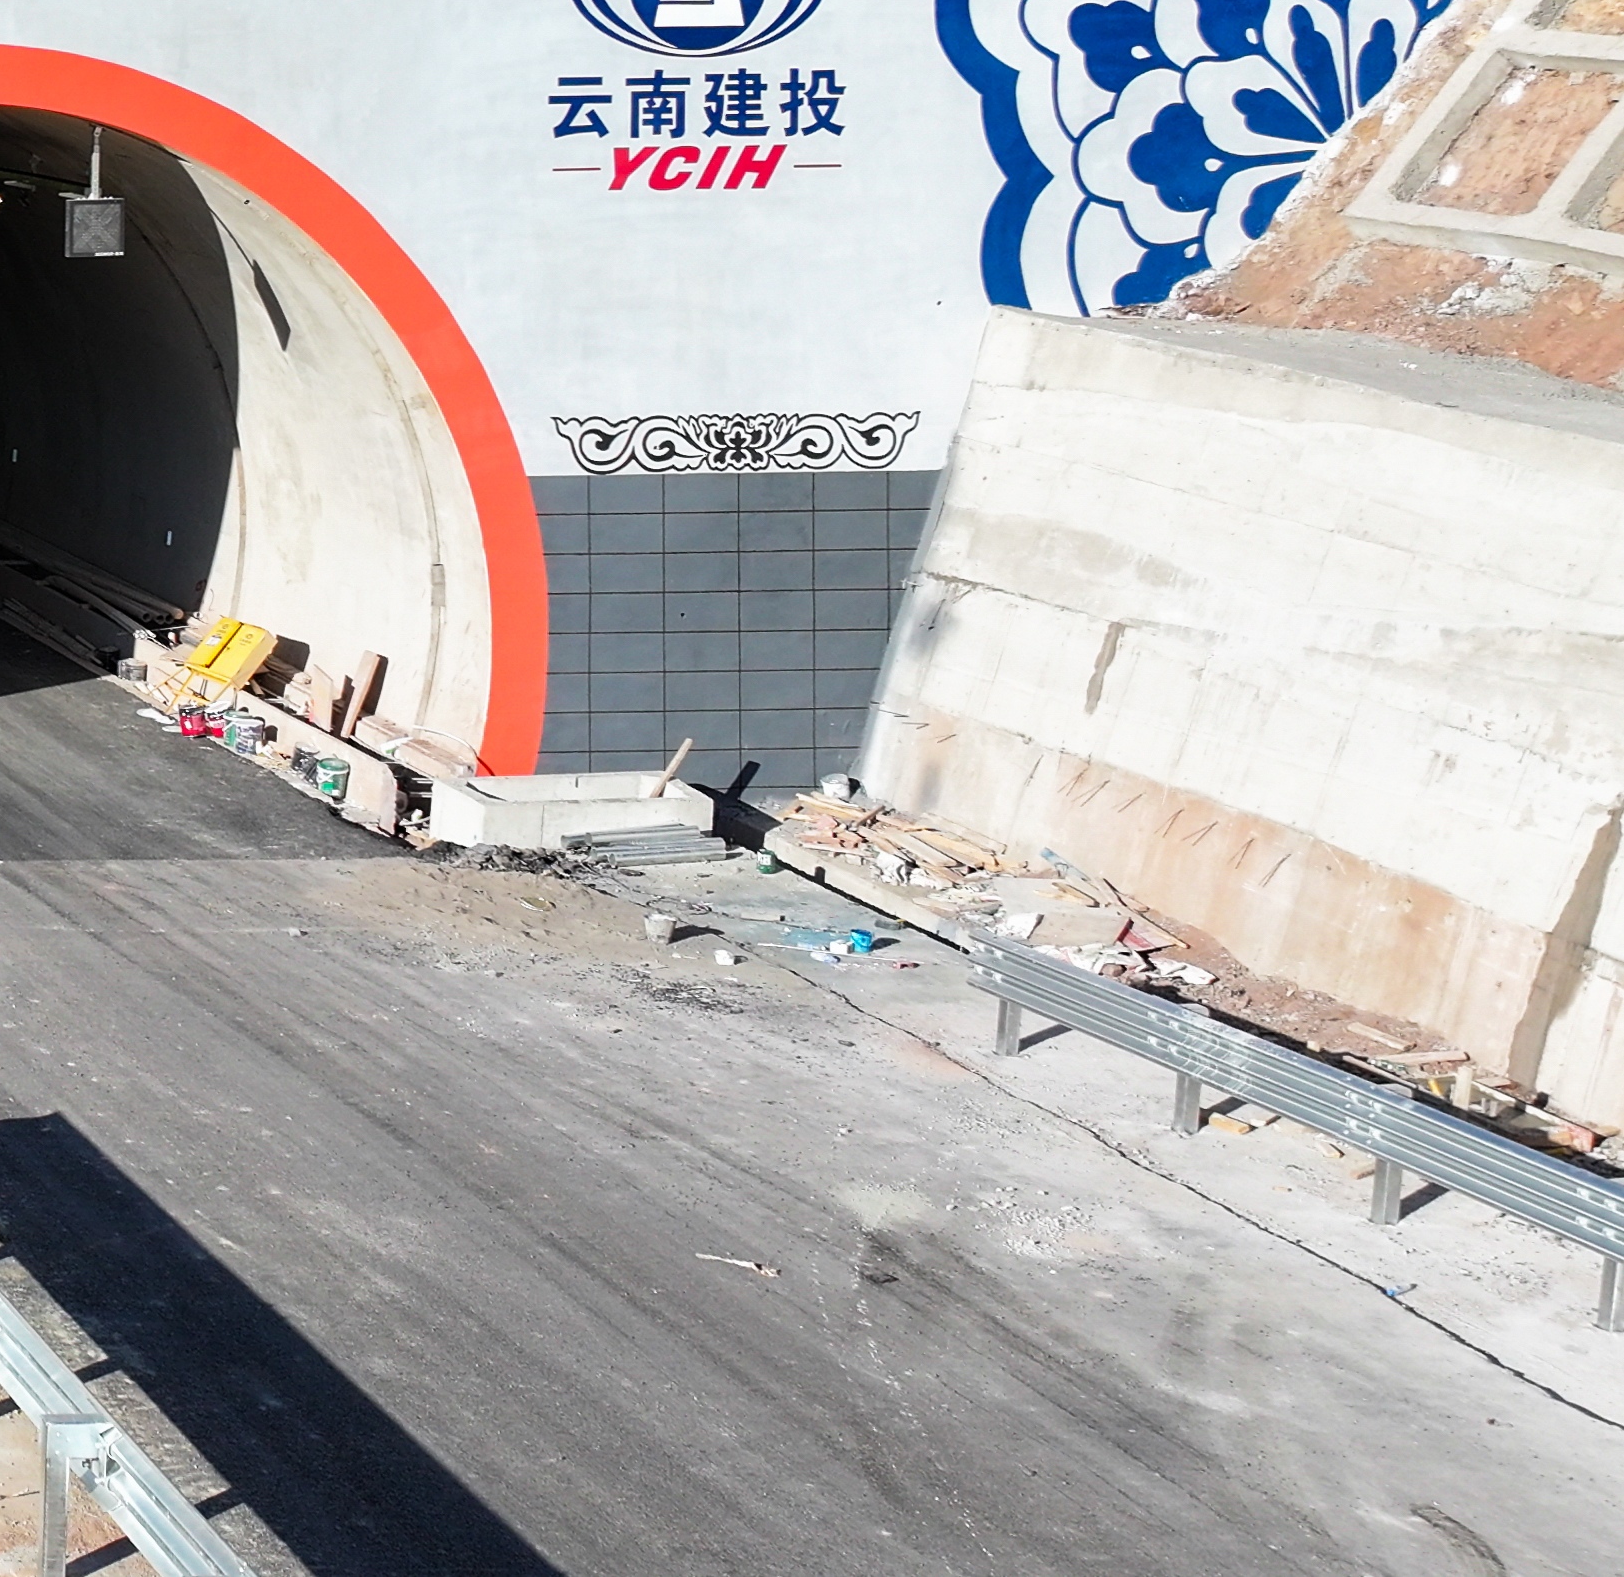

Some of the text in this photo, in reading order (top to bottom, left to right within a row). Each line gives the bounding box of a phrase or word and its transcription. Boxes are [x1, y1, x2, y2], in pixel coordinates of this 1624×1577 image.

[550, 69, 844, 138] 云南建投
[610, 145, 785, 190] YCIH
